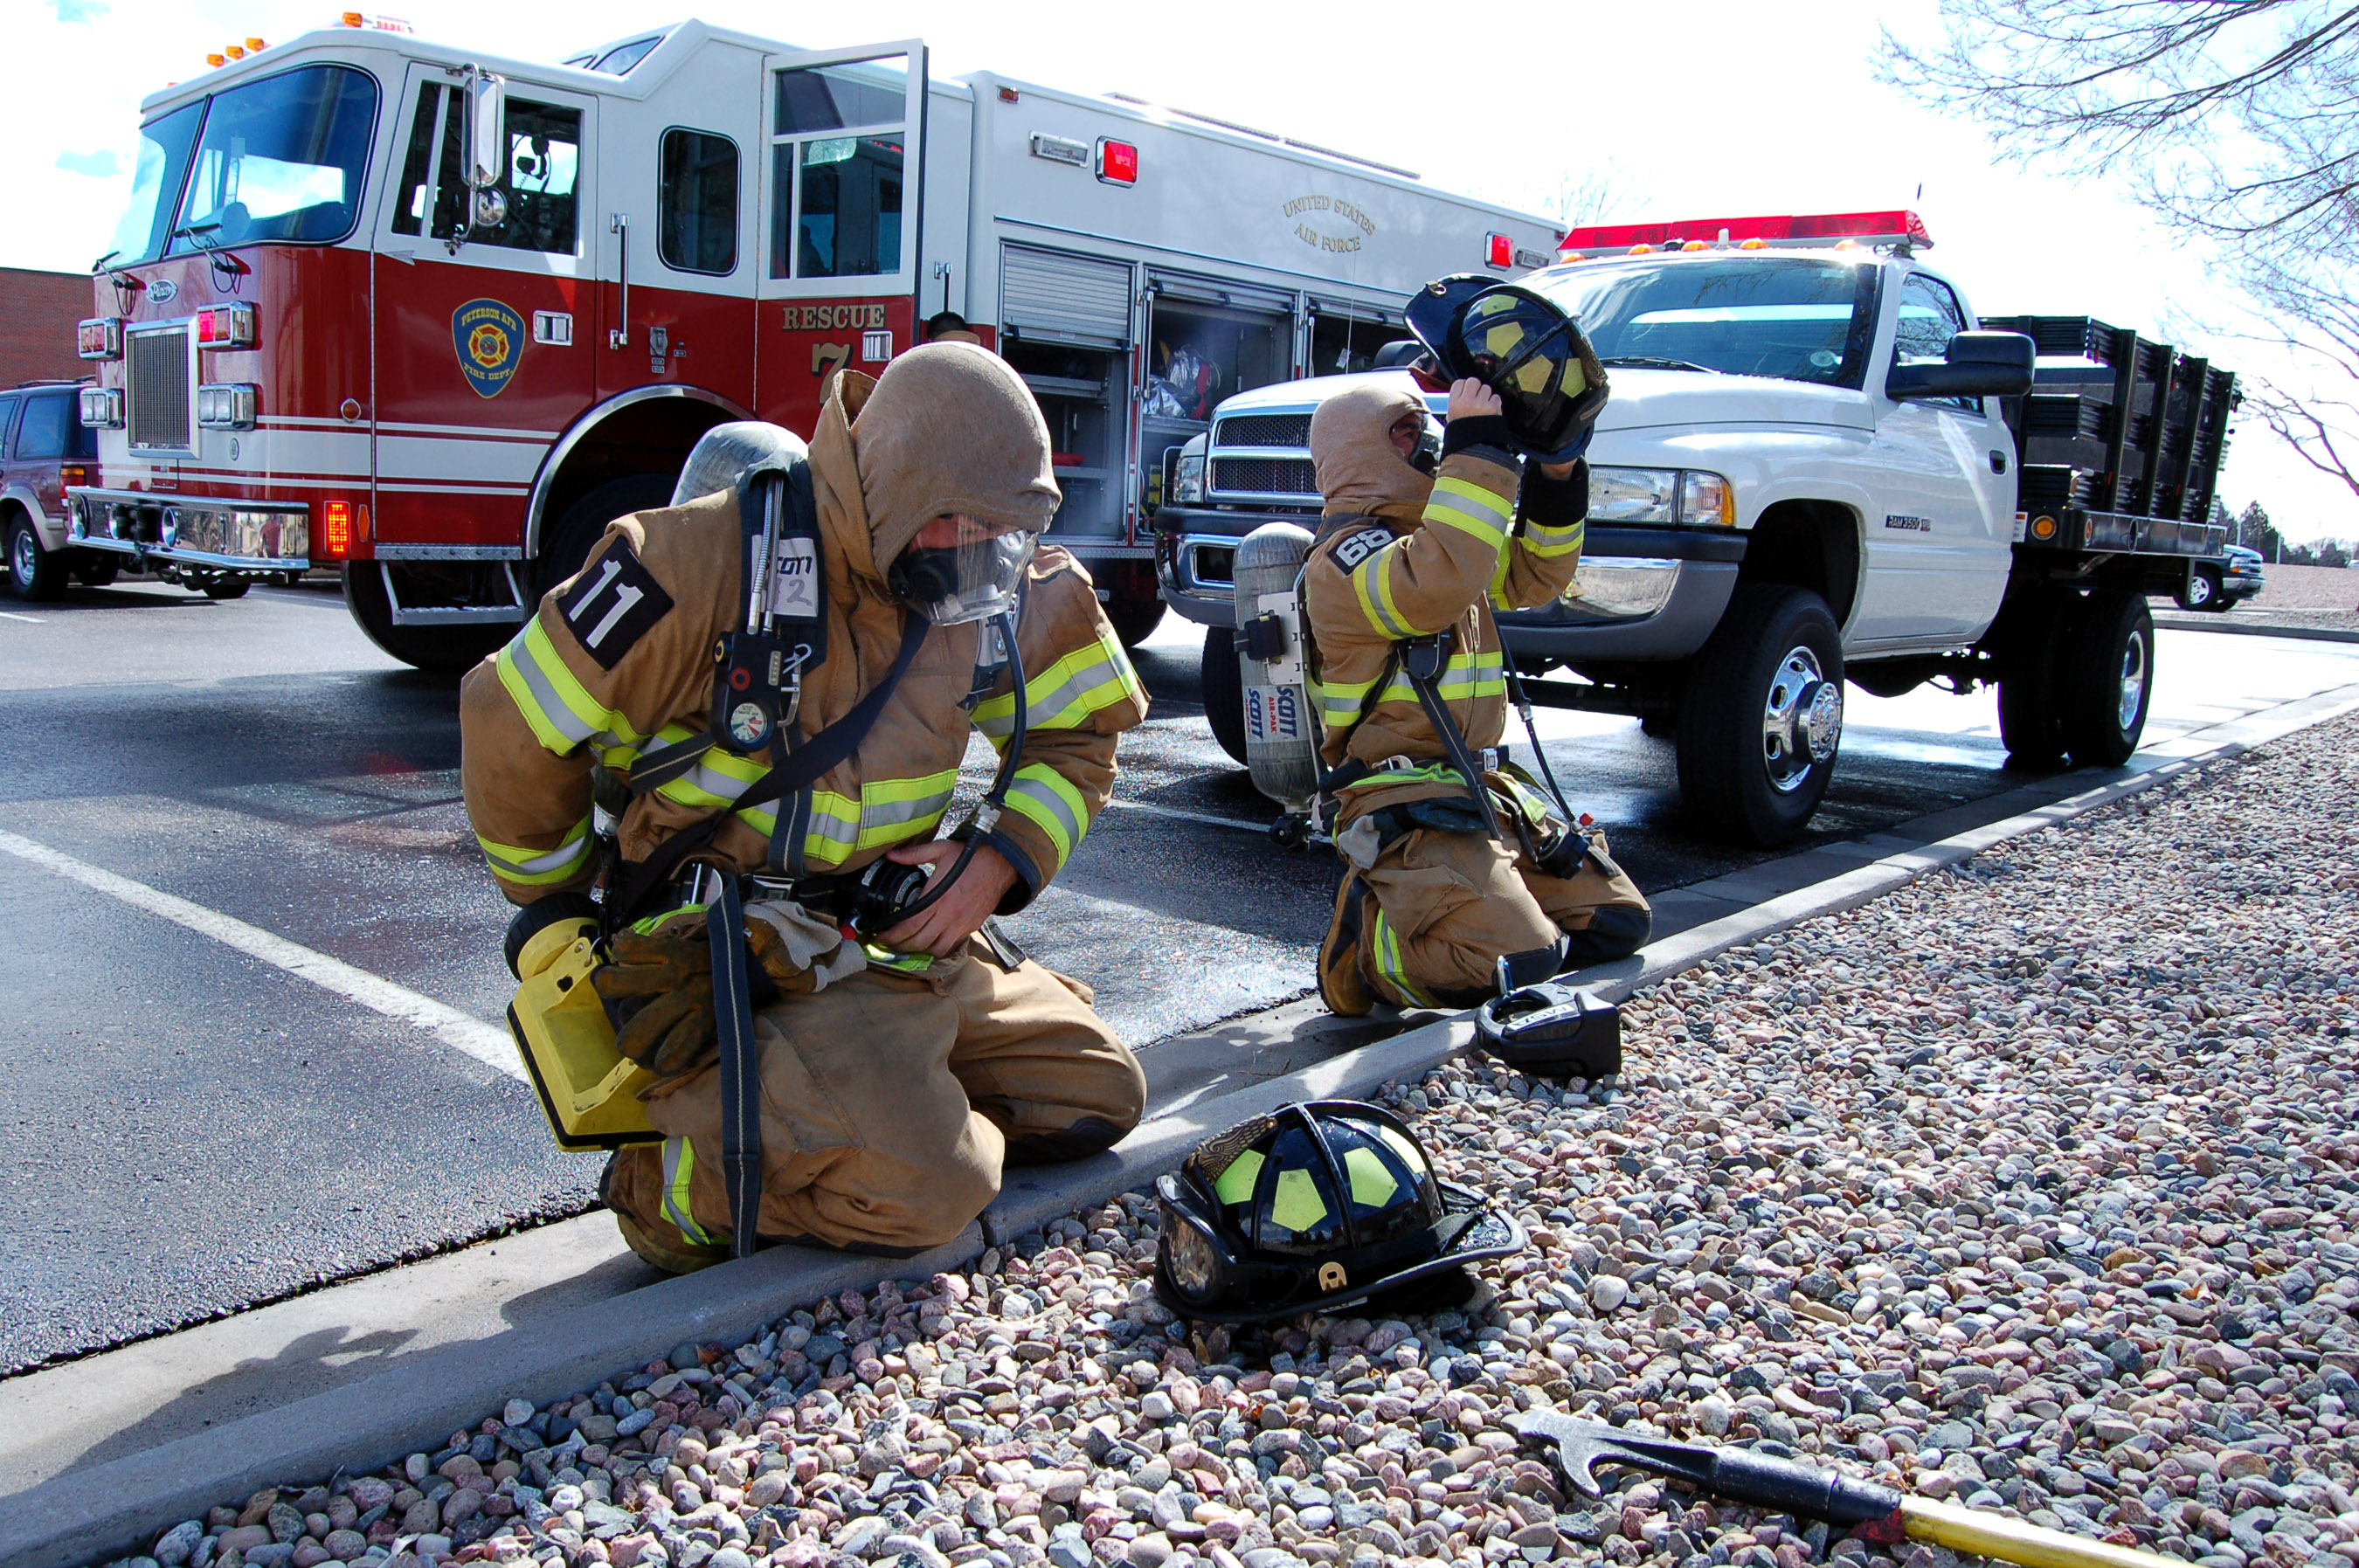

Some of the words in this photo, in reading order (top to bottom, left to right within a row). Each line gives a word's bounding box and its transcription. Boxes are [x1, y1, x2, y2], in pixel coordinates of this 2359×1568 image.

[1283, 195, 1331, 218] UNITED
[1334, 197, 1376, 237] STATES
[1294, 223, 1318, 247] AIR
[1321, 235, 1361, 253] FORCE
[460, 307, 501, 328] PETERSON
[782, 303, 886, 330] RESCUE
[463, 361, 486, 380] FIRE
[812, 342, 852, 404] 7
[766, 555, 813, 575] OTT
[1336, 529, 1393, 567] 68
[569, 559, 644, 649] 11
[1248, 687, 1264, 741] SCOTT
[1268, 696, 1278, 733] AIR-PAK
[1276, 686, 1297, 739] SCOTT
